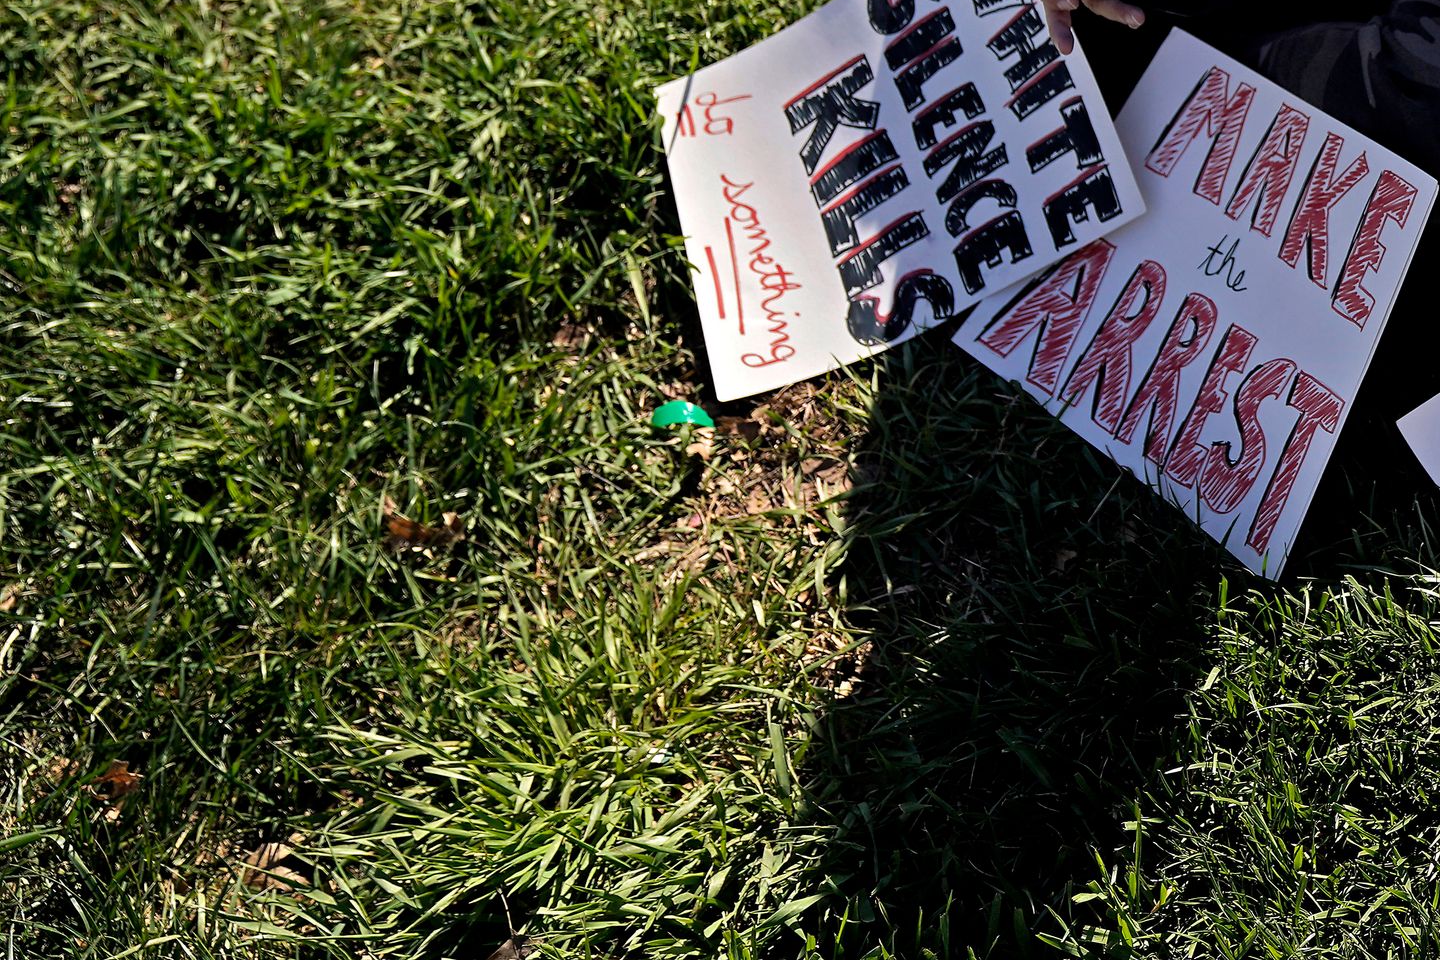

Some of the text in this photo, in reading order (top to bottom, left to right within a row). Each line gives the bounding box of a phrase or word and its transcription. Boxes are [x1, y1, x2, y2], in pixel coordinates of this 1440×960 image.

[694, 91, 802, 368] do something
[784, 54, 955, 347] KILLS
[1144, 66, 1419, 332] MAKE
[1197, 234, 1248, 293] the
[976, 237, 1347, 557] ARREST
